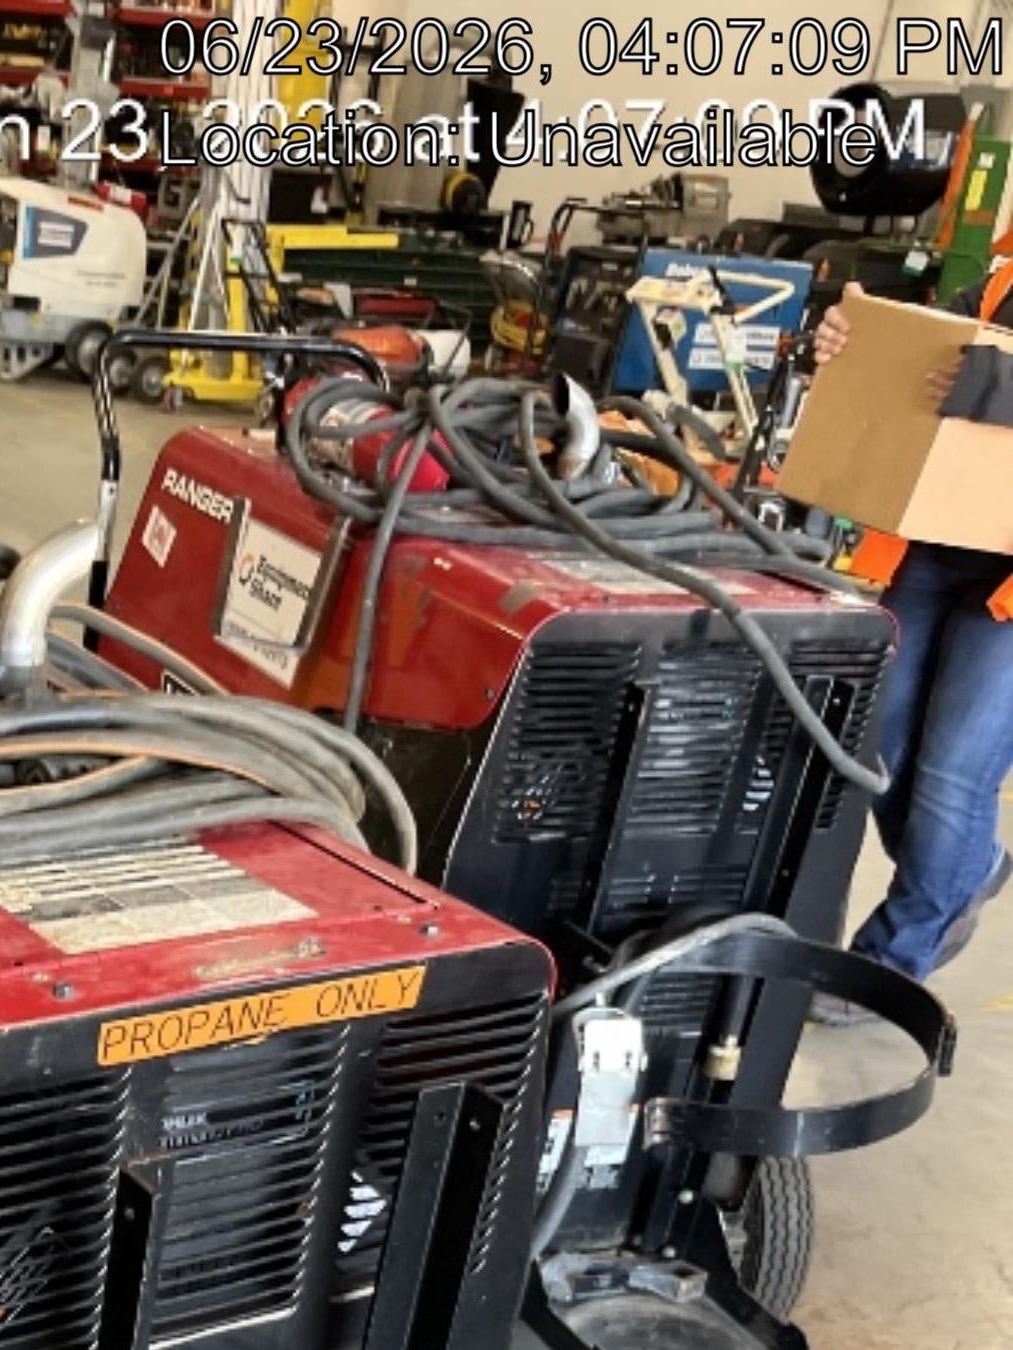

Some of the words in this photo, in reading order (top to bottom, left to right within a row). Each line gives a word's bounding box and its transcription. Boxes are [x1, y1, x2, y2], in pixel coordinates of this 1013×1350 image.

[161, 467, 235, 523] RANGER
[257, 554, 310, 602] Equipmen
[103, 992, 291, 1060] PROPANE
[315, 972, 418, 1018] ONLY
